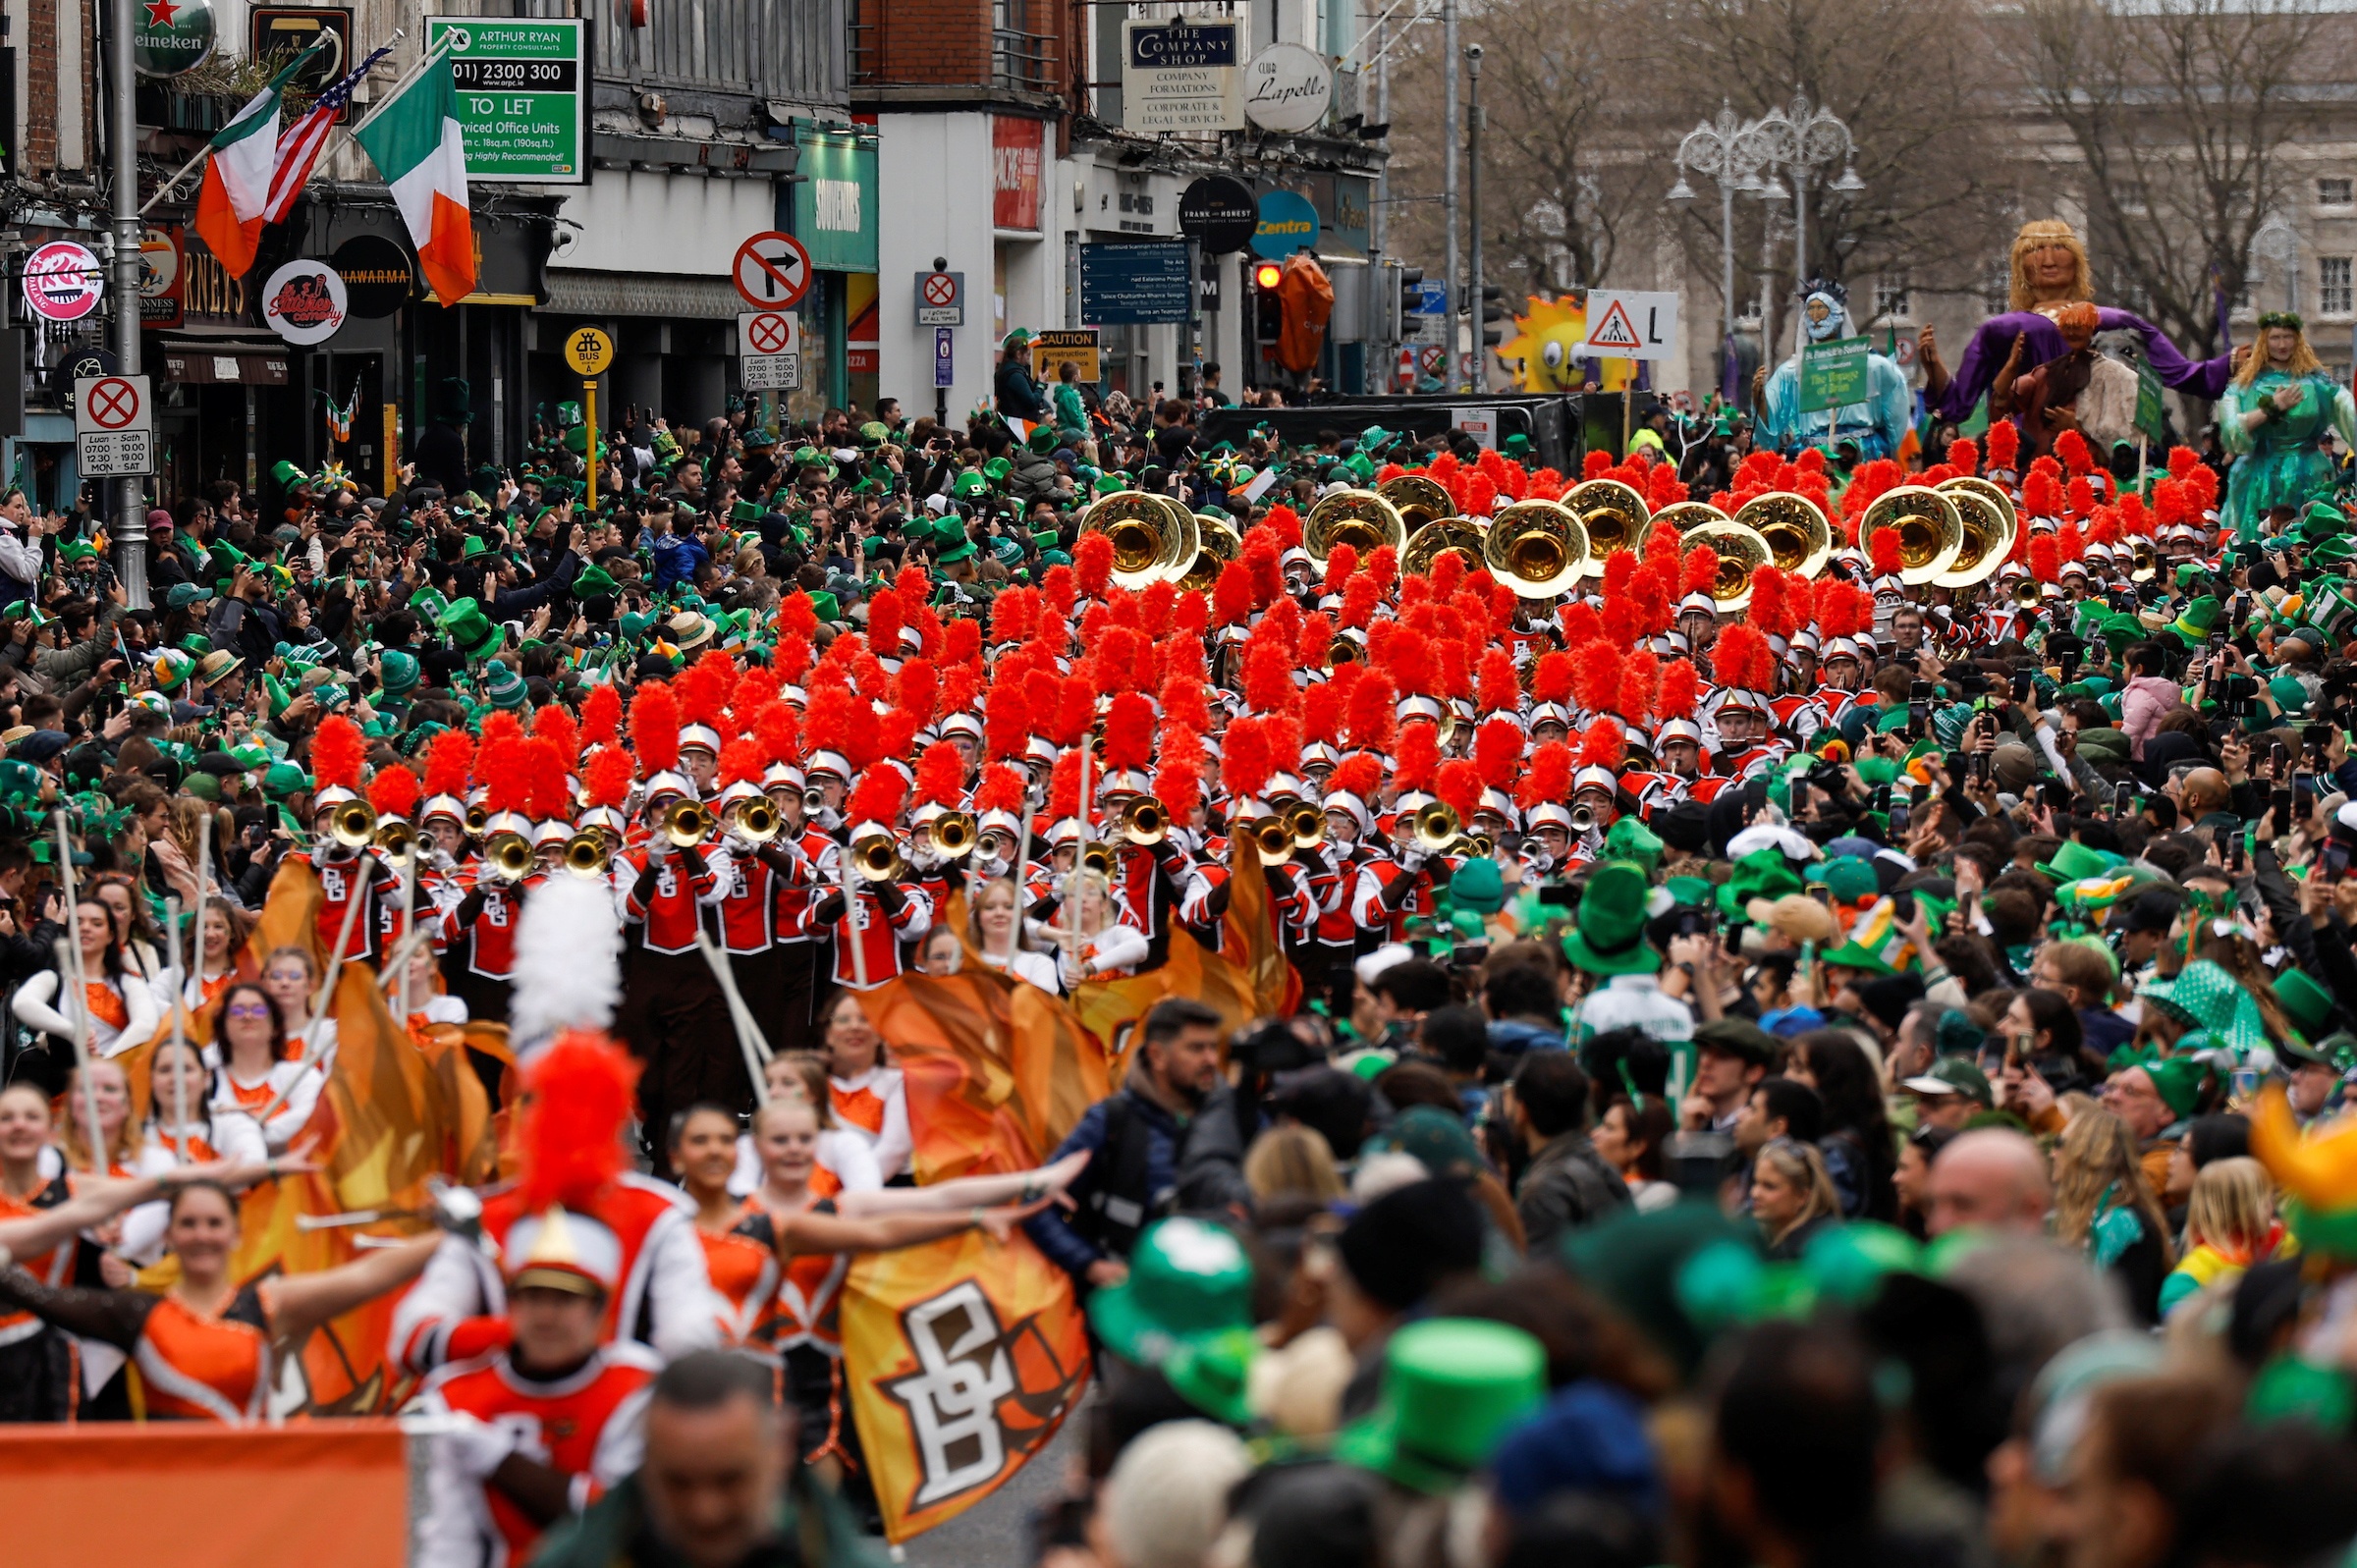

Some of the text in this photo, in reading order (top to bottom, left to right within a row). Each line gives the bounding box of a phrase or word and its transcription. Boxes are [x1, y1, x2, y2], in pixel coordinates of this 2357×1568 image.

[478, 31, 561, 42] ARTHUR RYAN
[1167, 28, 1200, 38] THE
[135, 32, 202, 49] eineken
[1138, 34, 1229, 58] COMPANY
[1160, 54, 1207, 65] SHOP
[452, 63, 561, 81] 01) 2300 300
[1258, 63, 1277, 75] CLUB
[1156, 73, 1209, 81] COMPANY
[1150, 84, 1217, 93] FORMATIONS
[1248, 76, 1325, 104] Lapello
[469, 97, 534, 115] TO LET
[1147, 102, 1219, 112] CORPORATE &
[1142, 115, 1226, 125] LEGAL SERVICES
[461, 121, 560, 135] rviced Office Units
[514, 138, 554, 149] (190sq.ft.)
[475, 152, 500, 162] Highly
[502, 152, 565, 162] Recommended!
[815, 178, 860, 233] SOUVENIRS
[1255, 219, 1312, 236] Centra
[341, 270, 407, 284] HAWARMA
[28, 276, 48, 308] DAILANG
[139, 298, 175, 307] INNESS
[292, 302, 343, 328] comedy
[1649, 306, 1663, 345] L
[1040, 333, 1092, 345] CAUTION
[586, 364, 592, 373] A
[84, 444, 110, 454] 07.00
[121, 443, 145, 452] 10.00
[86, 454, 110, 462] 12.30
[121, 453, 144, 461] 19.00
[325, 689, 350, 706] IREL
[322, 867, 347, 901] BG
